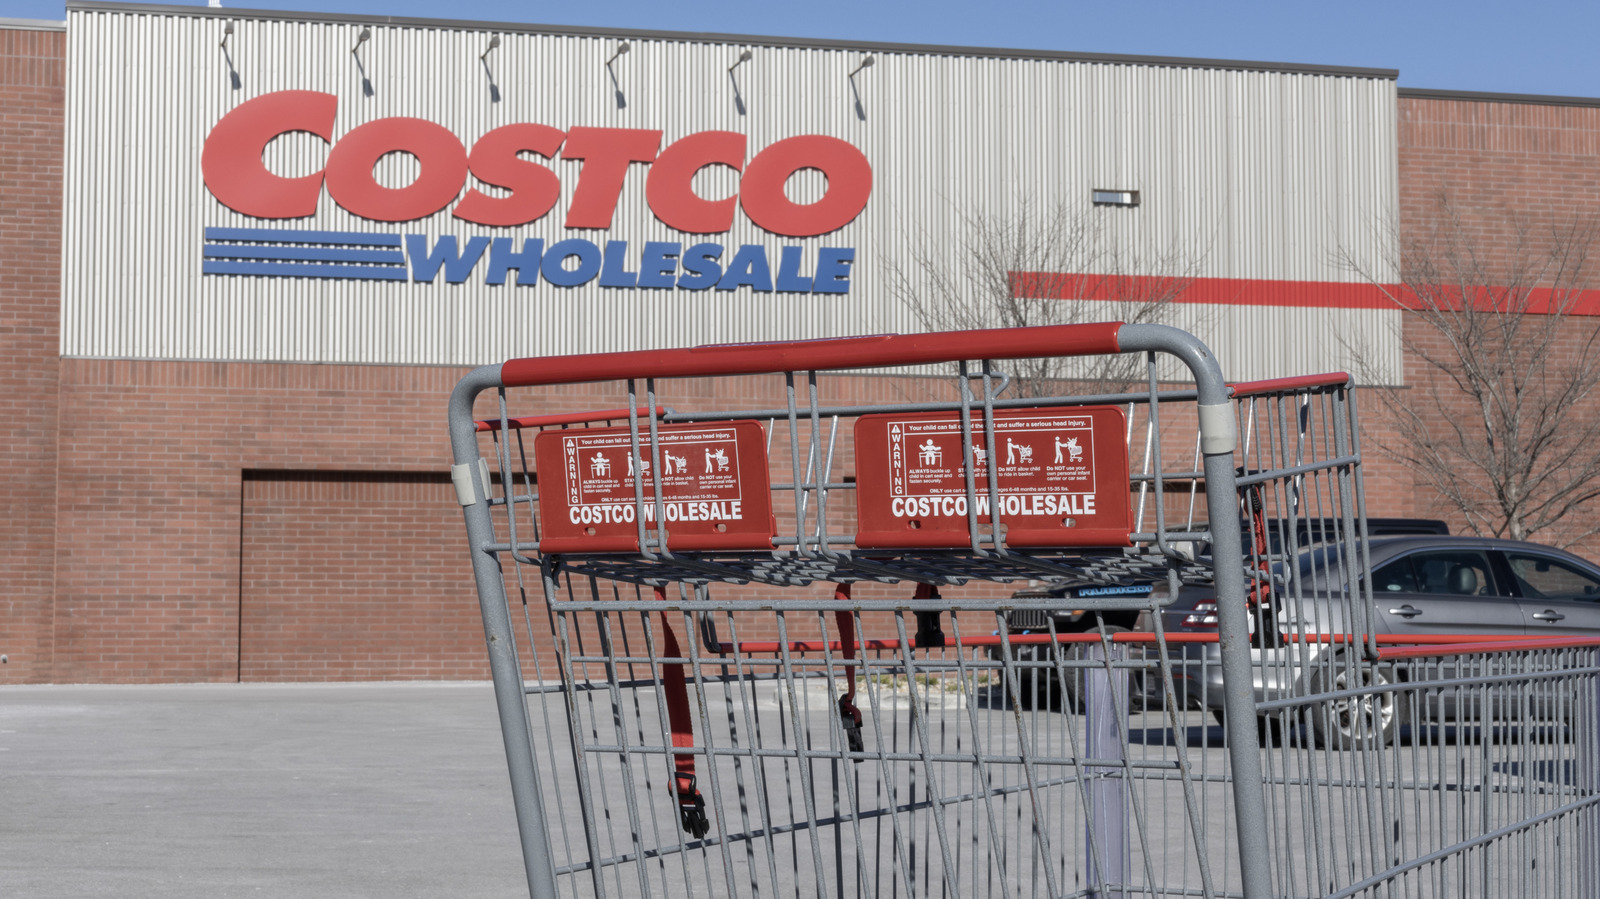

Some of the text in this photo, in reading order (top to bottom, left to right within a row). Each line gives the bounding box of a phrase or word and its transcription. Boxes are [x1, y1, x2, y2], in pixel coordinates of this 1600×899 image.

[201, 89, 873, 237] COSTCO
[405, 234, 855, 294] WHOLESALE
[566, 448, 578, 504] WARNING
[892, 434, 902, 495] WARNING
[569, 504, 635, 524] COSTCO
[892, 495, 1096, 518] COSTCO WHOLESALE
